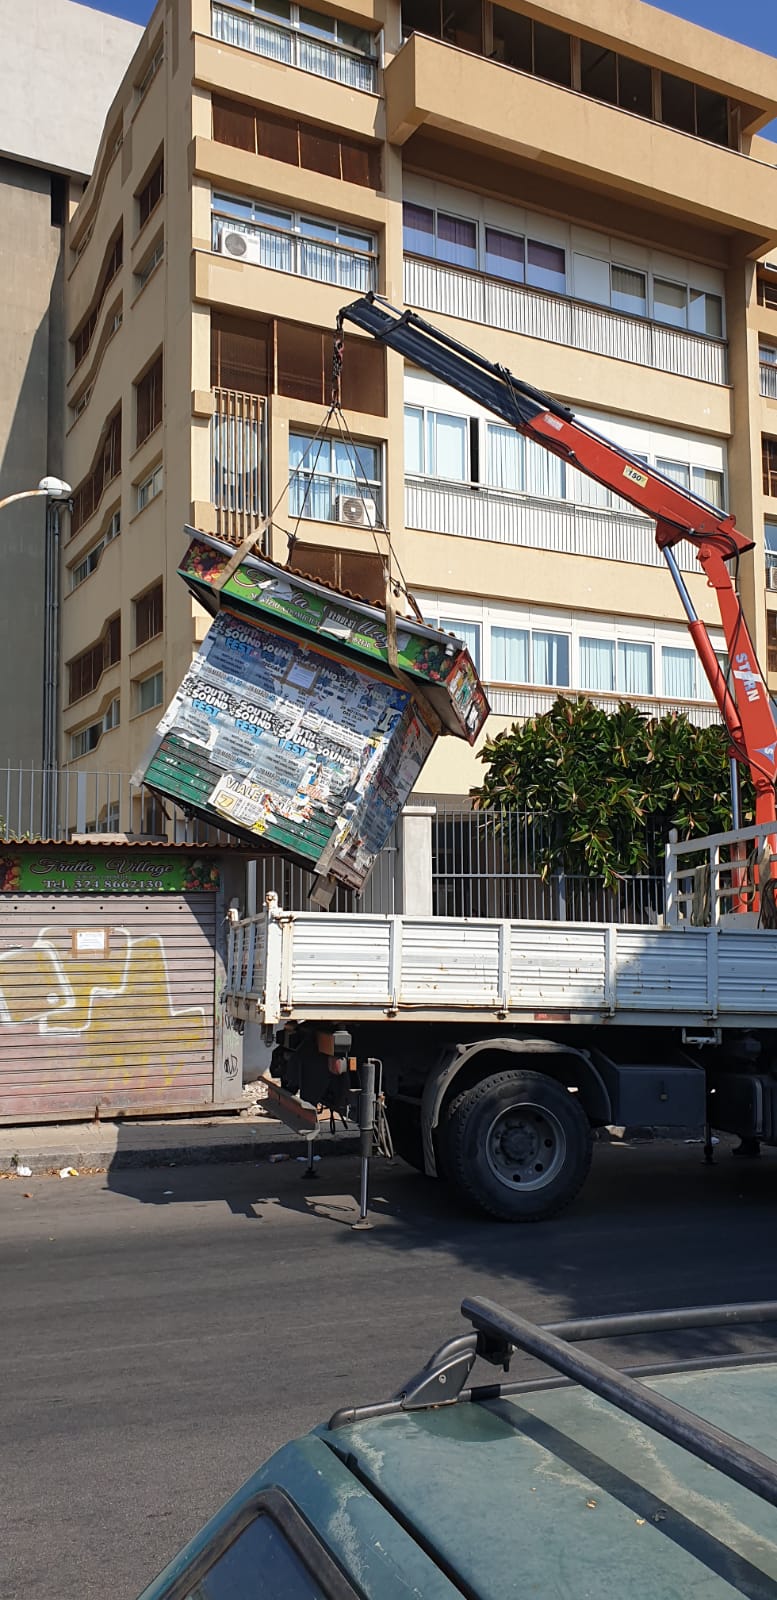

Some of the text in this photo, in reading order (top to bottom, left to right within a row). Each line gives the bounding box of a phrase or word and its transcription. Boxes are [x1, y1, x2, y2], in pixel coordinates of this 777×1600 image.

[627, 470, 642, 481] 150
[223, 626, 262, 649] SOUND
[223, 636, 254, 656] FEST
[190, 688, 229, 710] SOUND
[198, 680, 229, 702] SOUTH
[190, 697, 221, 718] FEST
[238, 700, 273, 721] SOUTH
[232, 717, 264, 738] FEST
[234, 708, 272, 730] SOUND
[223, 776, 262, 802] VIALE
[216, 793, 234, 810] 7
[30, 858, 174, 877] Frutta Village
